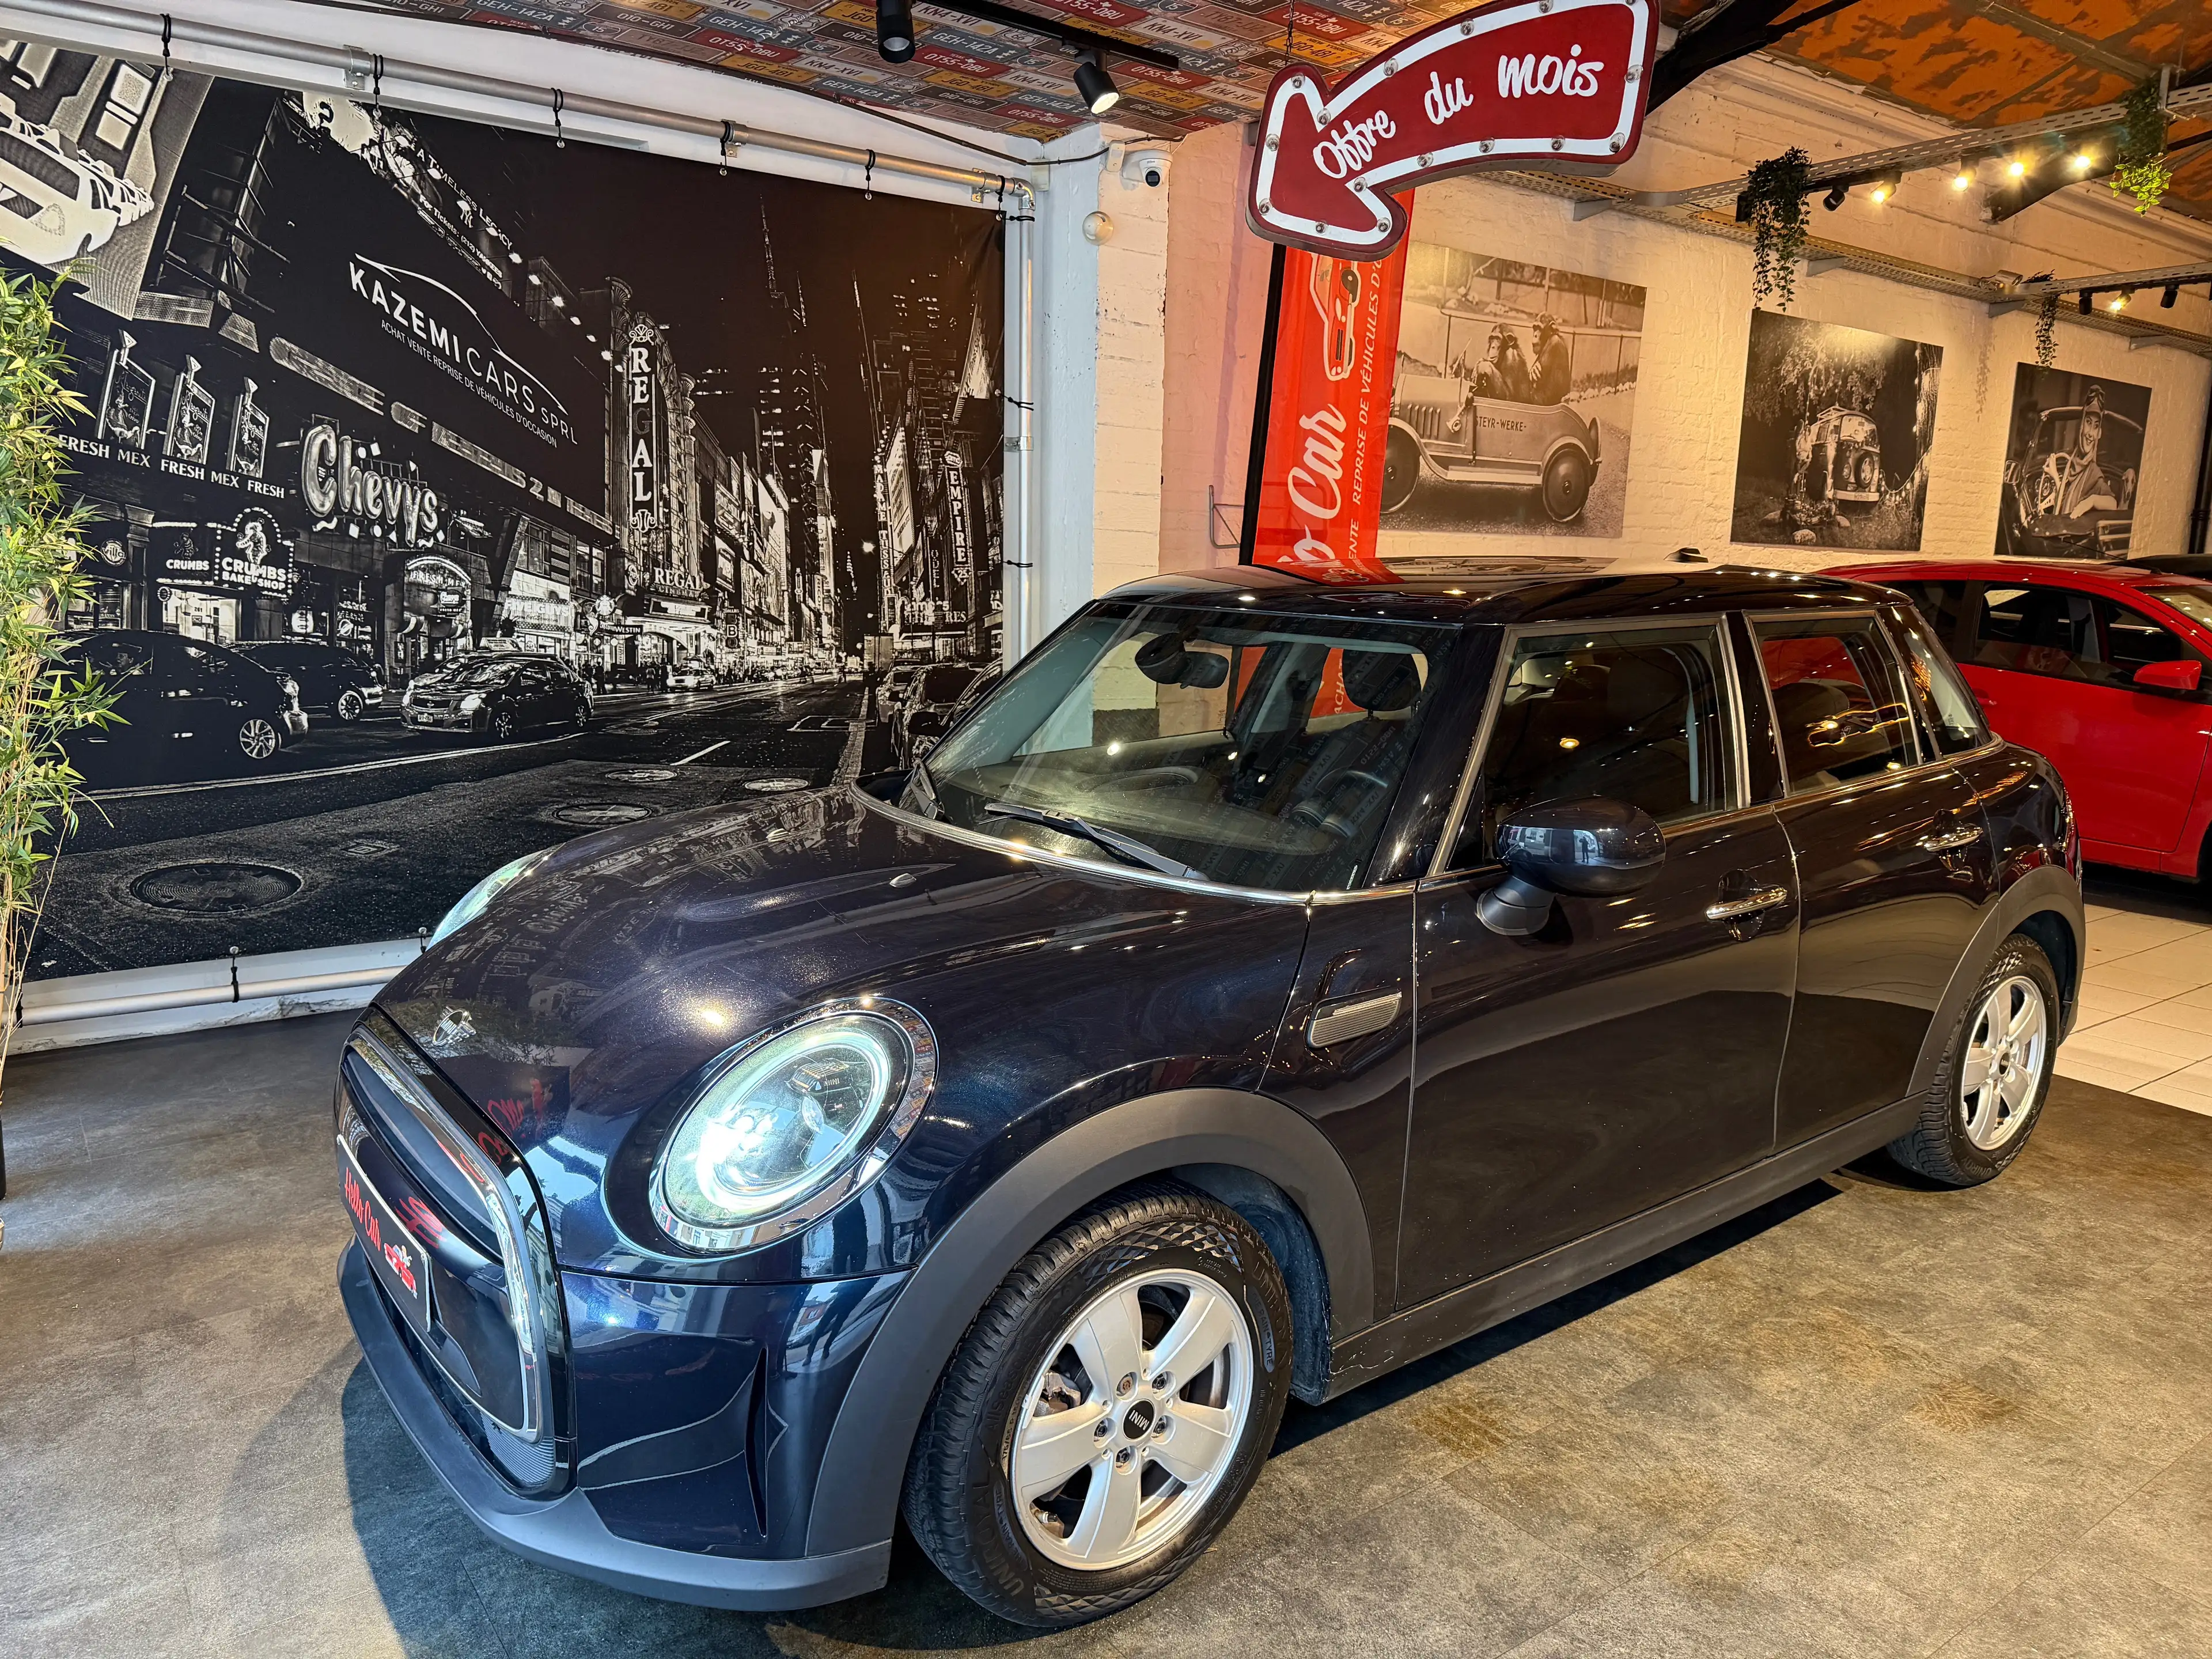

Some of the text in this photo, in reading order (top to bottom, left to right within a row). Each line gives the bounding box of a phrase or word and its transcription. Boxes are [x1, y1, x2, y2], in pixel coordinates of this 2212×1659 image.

[1166, 2, 1183, 10] 15
[1389, 17, 1406, 25] 15
[1313, 110, 1396, 179] Offre
[1424, 71, 1474, 125] du
[428, 154, 478, 213] TMELESS
[349, 260, 578, 446] KAZEMI CARS SPRL
[1360, 290, 1380, 393] VÉHICULES
[381, 319, 558, 449] ACHAT VENTE REPRISE DE VÉHICULES D'OCCASION
[1359, 400, 1369, 422] DE
[630, 347, 653, 502] REGAL
[58, 434, 286, 499] FRESH MEX FRESH MEX FRESH
[301, 424, 439, 548] Chevys
[1287, 403, 1347, 520] Car
[1352, 430, 1368, 506] REPRISE
[948, 470, 967, 563] EMPIRE
[1349, 518, 1360, 560] ENTE
[165, 559, 210, 571] CRUMBS
[221, 556, 287, 582] CRUMBS
[653, 566, 703, 591] REGAL
[615, 626, 641, 634] WESTIN
[344, 1166, 382, 1251] Hello Car
[1265, 1339, 1273, 1366] TYRE
[1129, 1410, 1150, 1431] MINI
[995, 1488, 1005, 1516] TYRE
[971, 1470, 1025, 1598] UNIROYAL
[1001, 1524, 1015, 1548] RAIN
